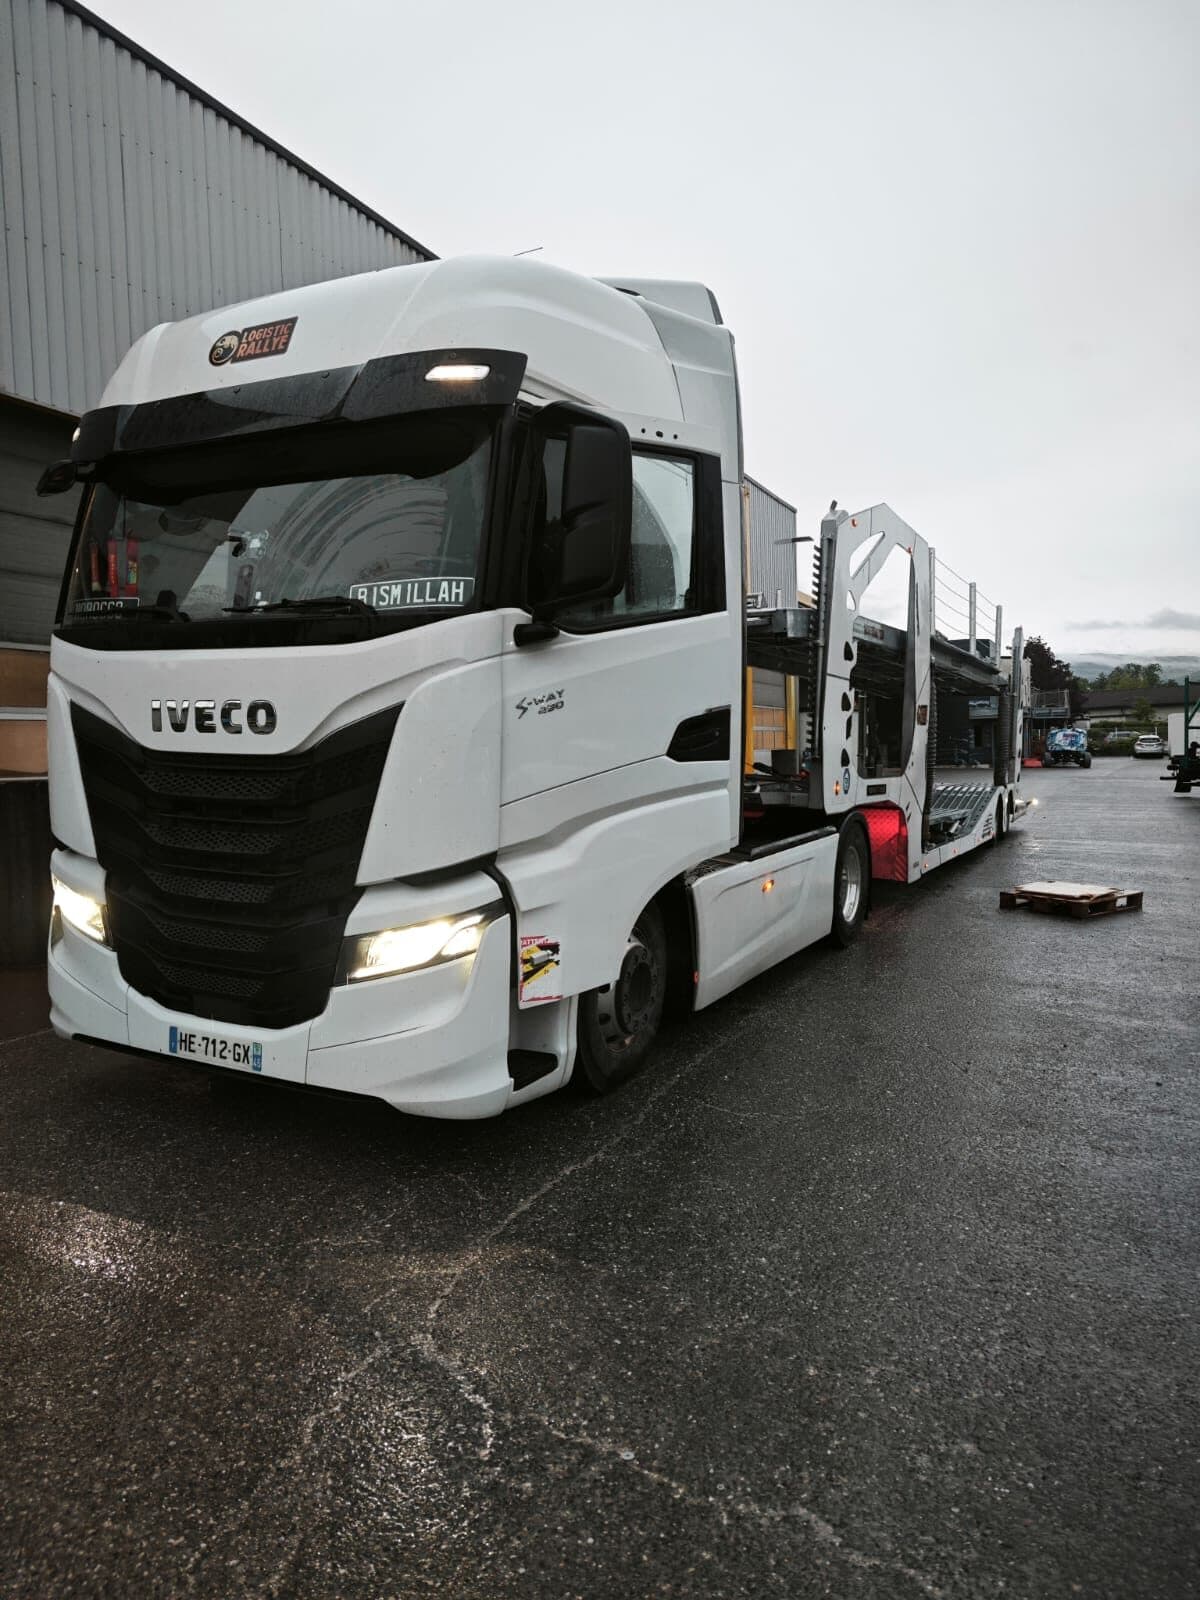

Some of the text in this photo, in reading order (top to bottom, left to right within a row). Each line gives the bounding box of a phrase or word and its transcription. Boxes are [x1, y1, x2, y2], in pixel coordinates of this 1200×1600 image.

[236, 334, 289, 358] RALLYE
[241, 322, 292, 343] LOGISTIC
[151, 699, 277, 735] IVECO
[179, 1031, 251, 1065] HE-712-GX
